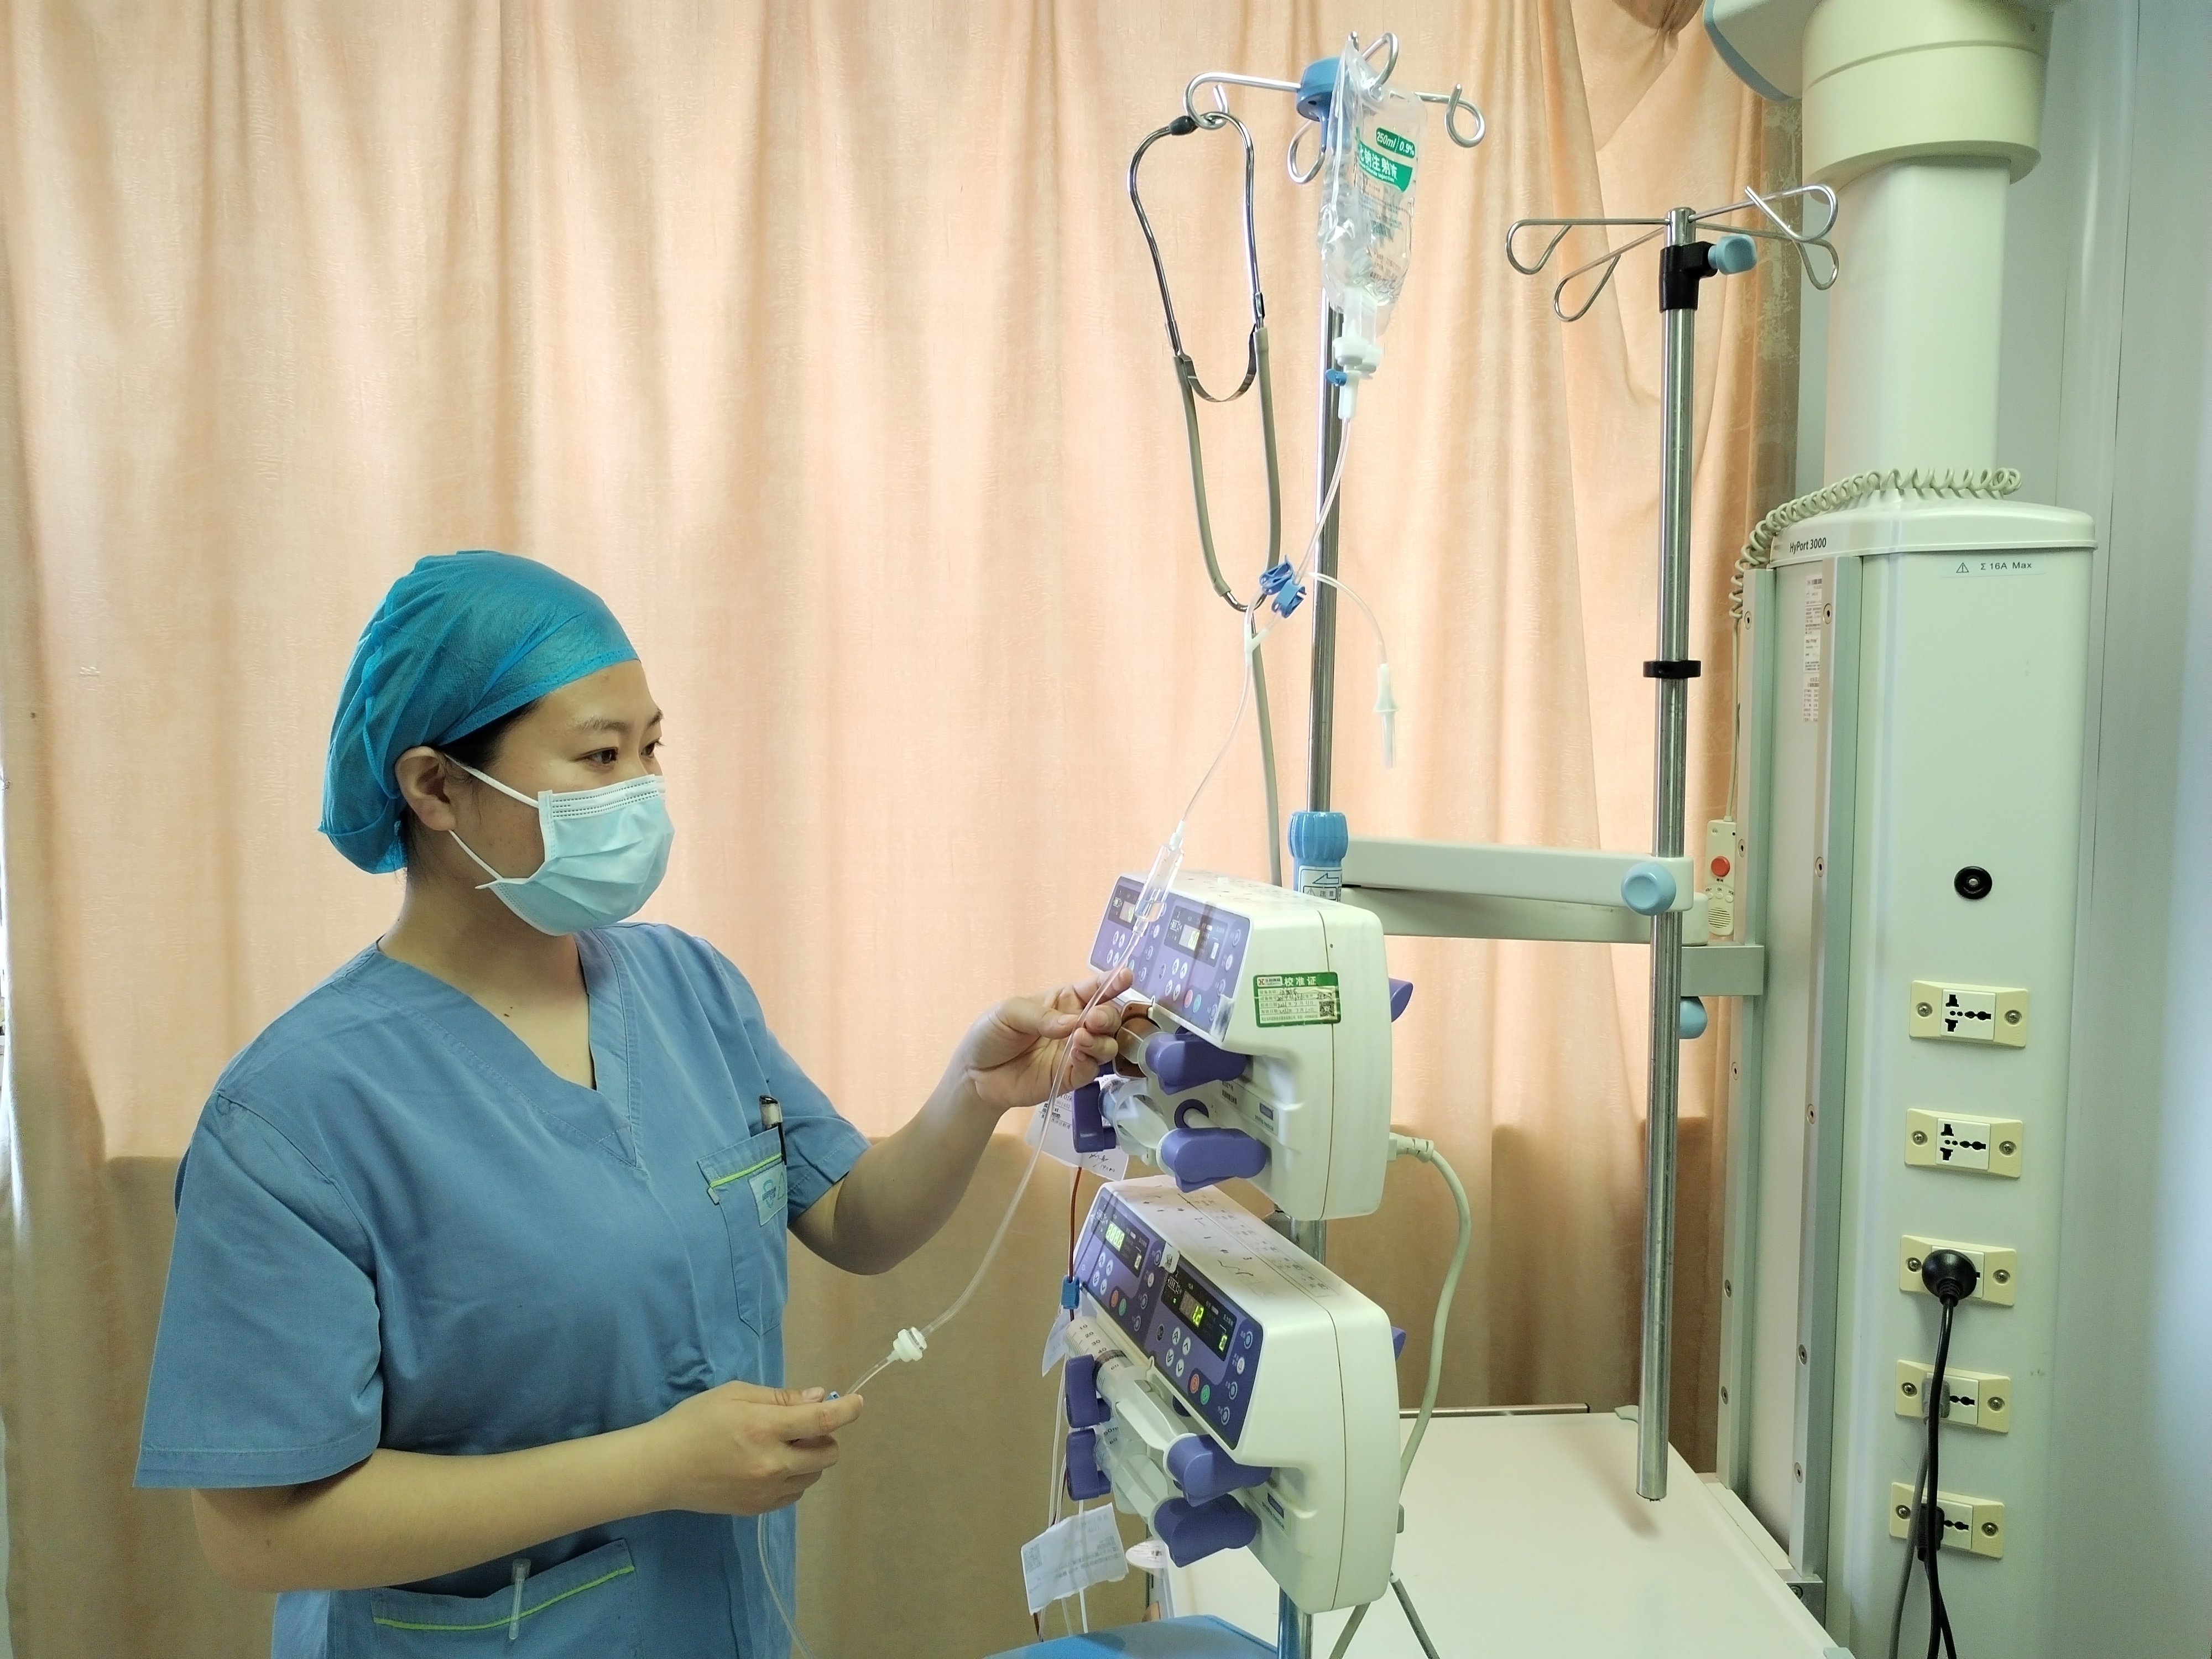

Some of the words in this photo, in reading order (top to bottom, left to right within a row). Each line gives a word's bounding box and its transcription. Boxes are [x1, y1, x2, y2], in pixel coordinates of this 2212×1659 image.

[1377, 131, 1397, 148] 250ml
[1399, 140, 1414, 156] 0.9%
[1790, 540, 1809, 555] HyPort
[1810, 537, 1827, 549] 3000
[1284, 975, 1317, 987] 校准证
